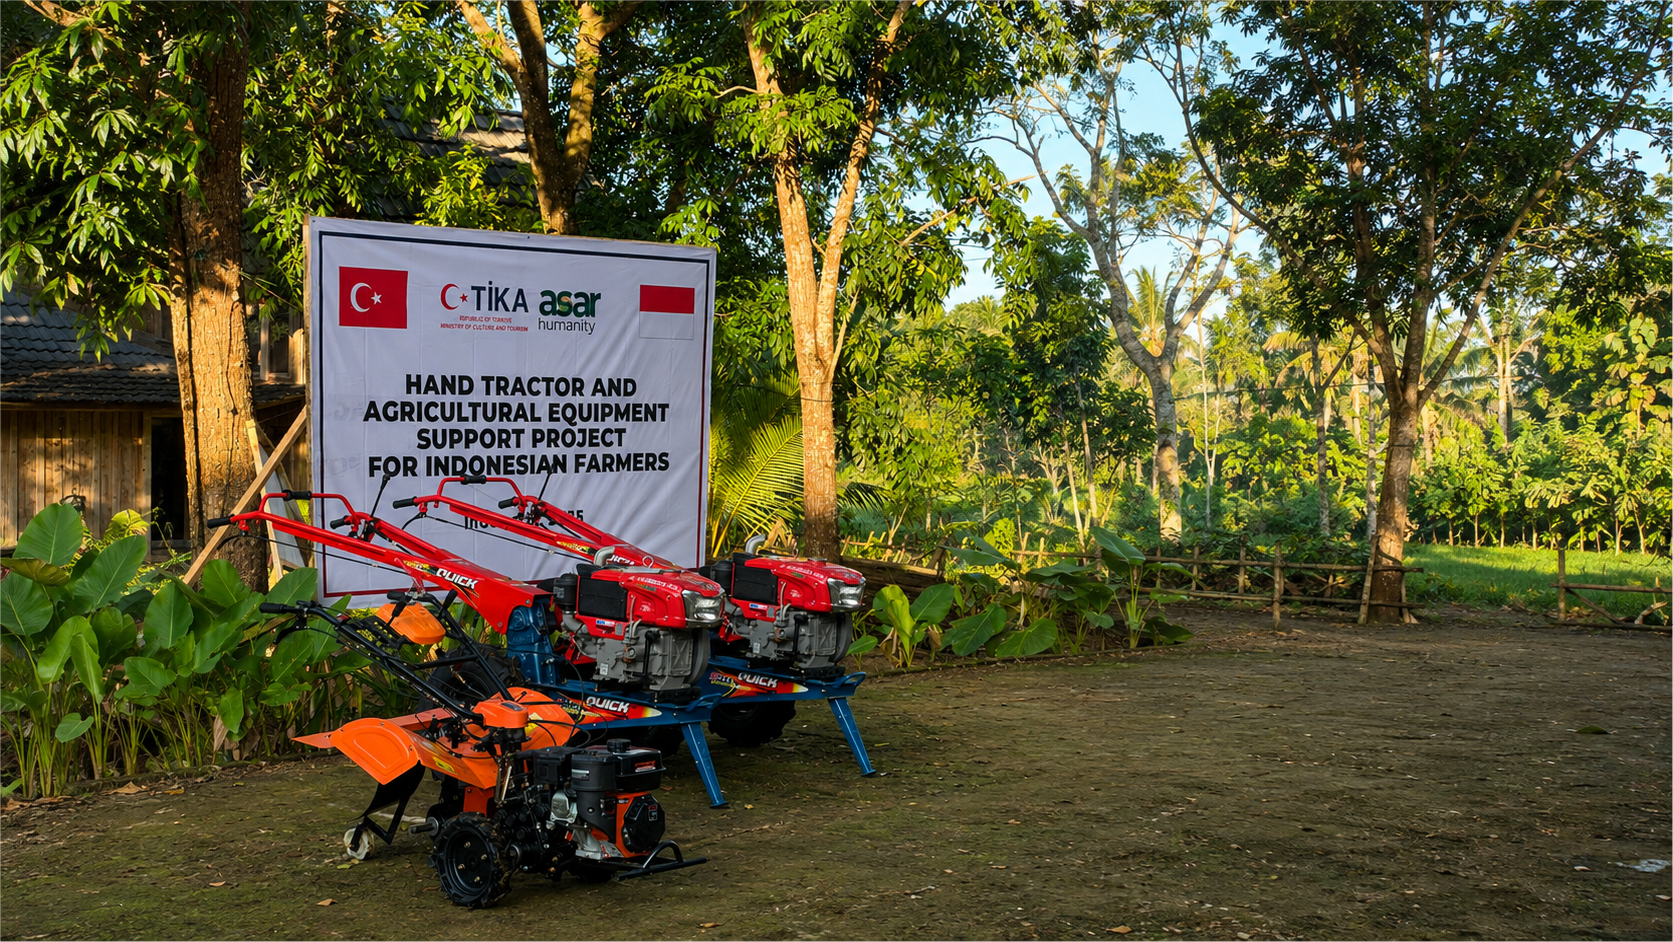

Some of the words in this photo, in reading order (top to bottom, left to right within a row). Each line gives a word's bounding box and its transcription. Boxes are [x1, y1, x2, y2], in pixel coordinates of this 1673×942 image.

[471, 281, 529, 313] TİKA
[539, 290, 601, 318] asar
[538, 318, 596, 336] humanity
[405, 374, 475, 396] HAND
[481, 376, 585, 397] TRACTOR
[591, 378, 637, 397] AND
[363, 401, 542, 423] AGRICULTURAL
[548, 403, 670, 427] EQUIPMENT
[416, 429, 526, 450] SUPPORT
[532, 428, 627, 448] PROJECT
[368, 456, 418, 477] FOR
[426, 454, 567, 477] INDONESIAN
[574, 452, 670, 473] FARMERS
[436, 568, 479, 590] QUICK
[738, 672, 778, 688] QUICK
[586, 696, 630, 713] QUICK
